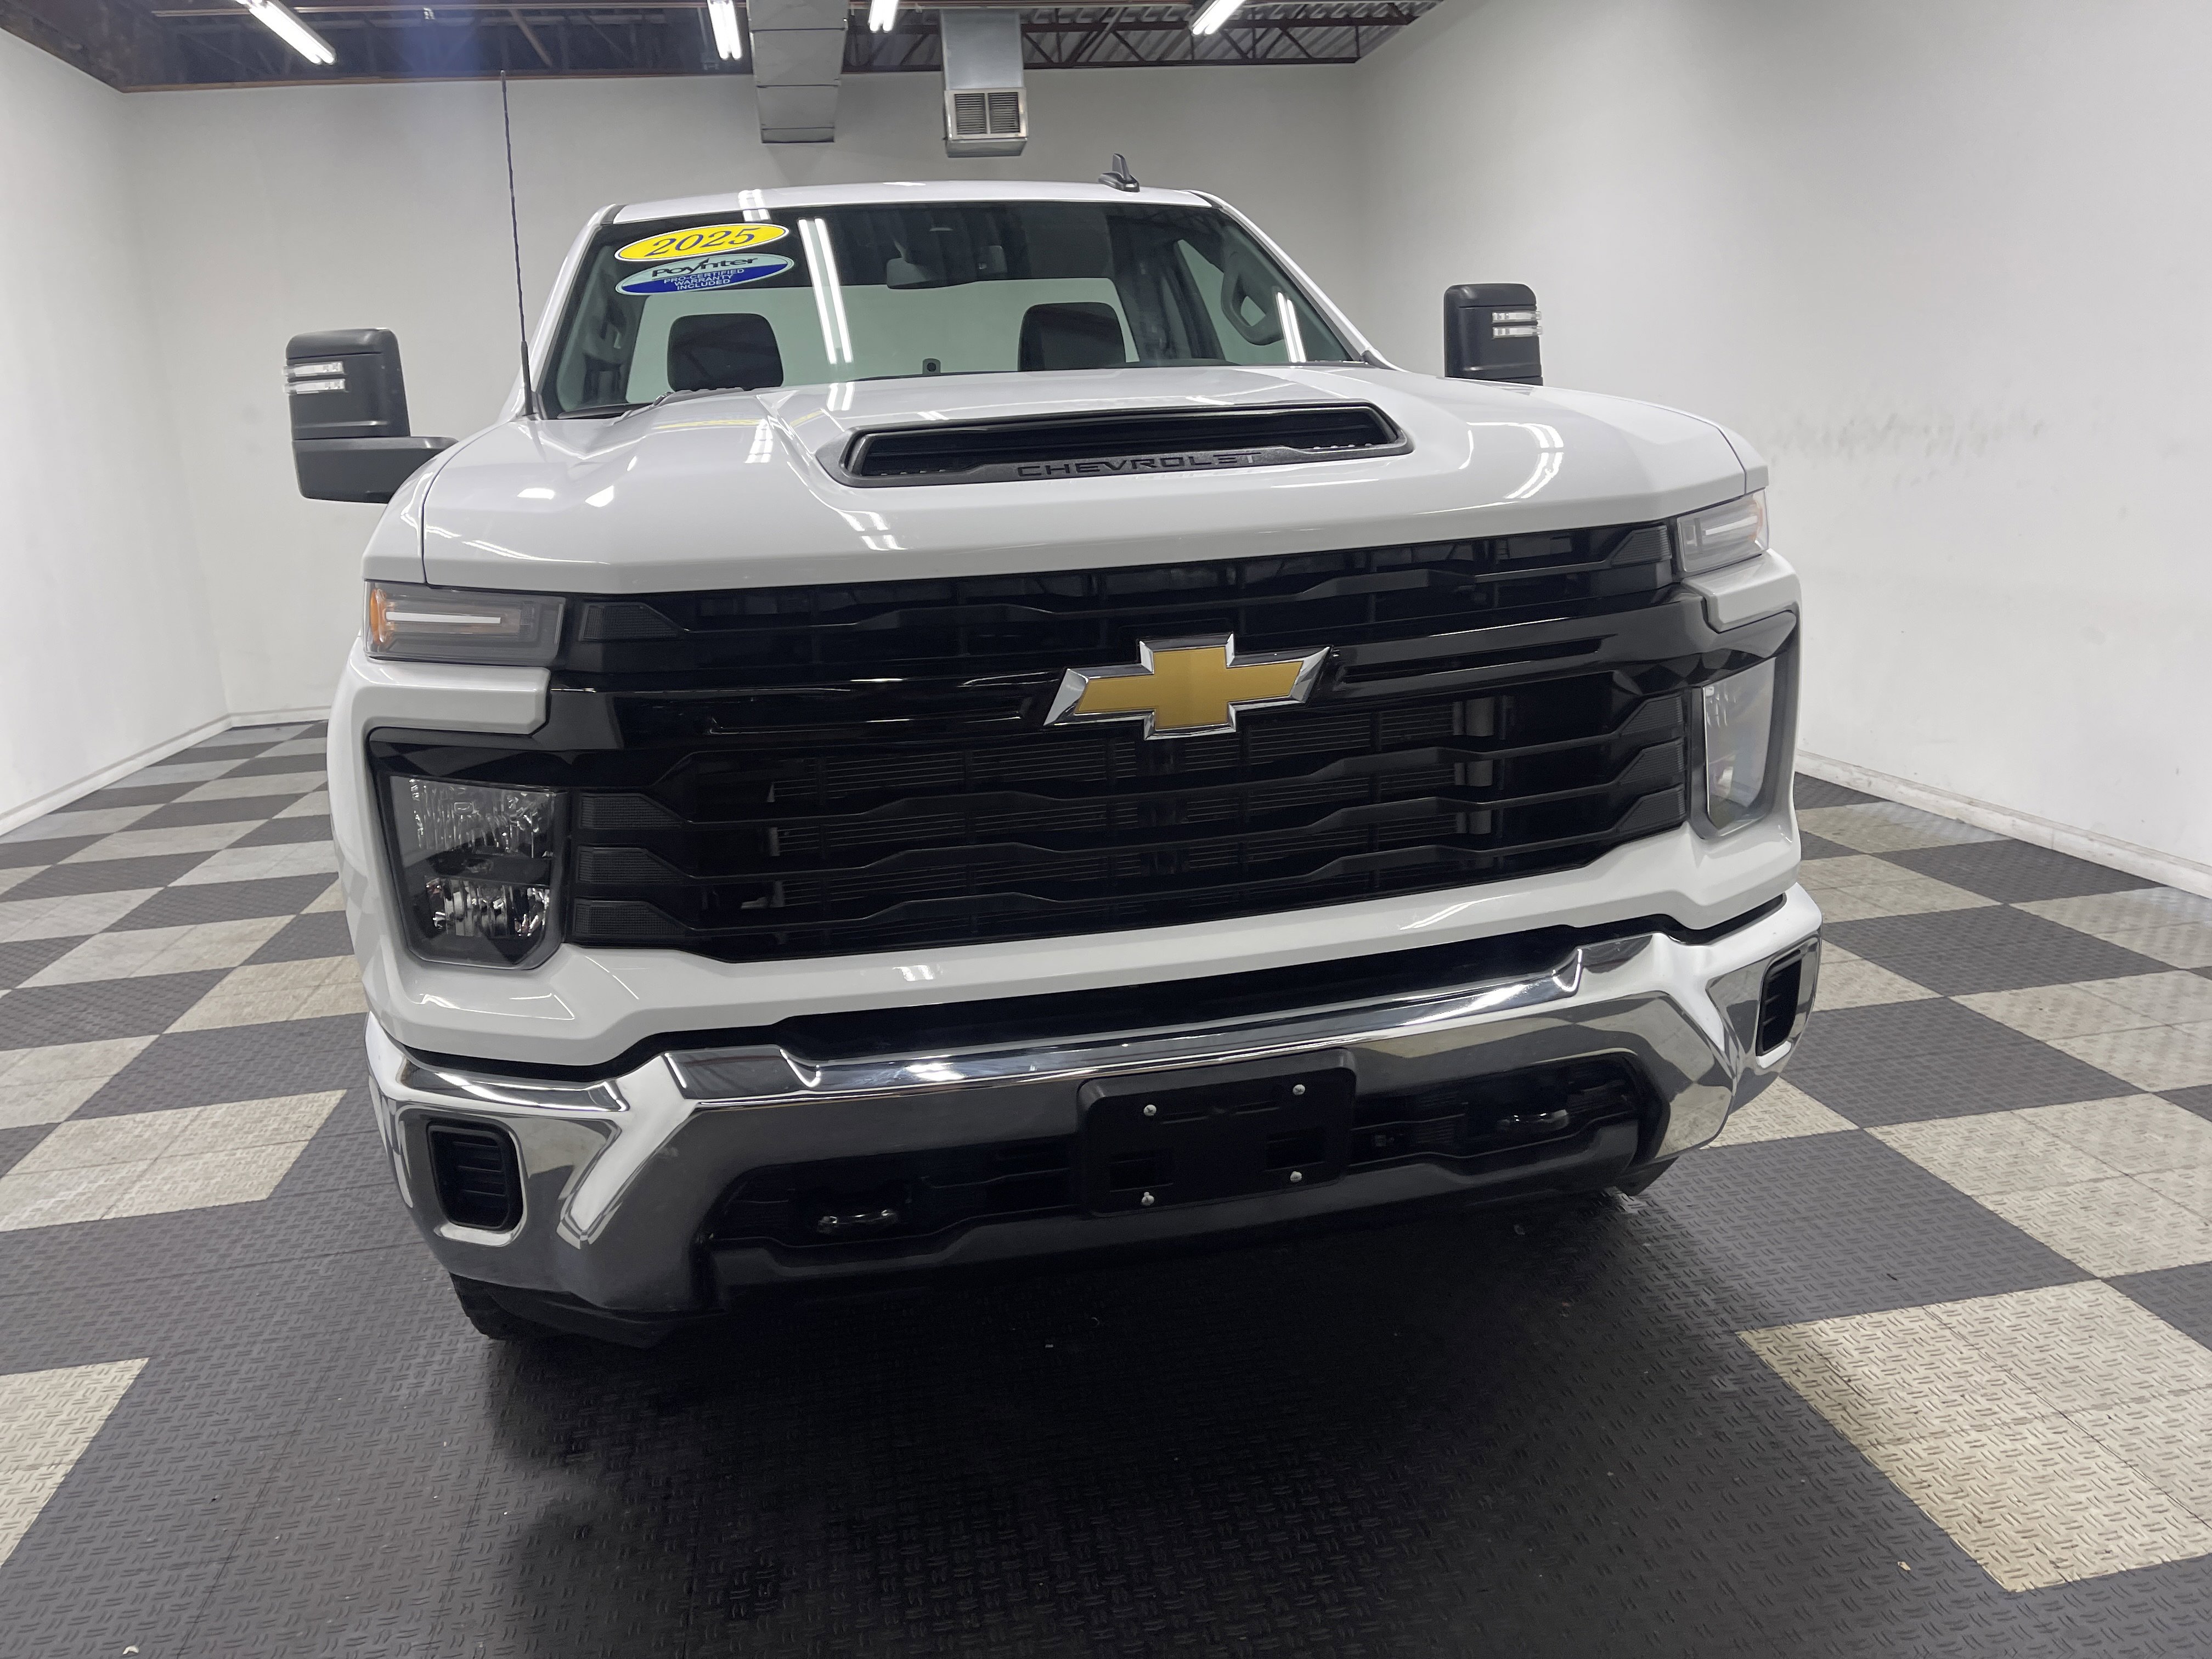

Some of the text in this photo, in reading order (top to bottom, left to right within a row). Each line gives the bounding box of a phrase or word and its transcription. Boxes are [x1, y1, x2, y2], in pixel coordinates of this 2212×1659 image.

[644, 227, 761, 257] 2025
[663, 269, 745, 284] PRO-CERTIFIED
[674, 274, 733, 286] WARRANTY
[677, 279, 730, 290] INCLUDED
[1017, 452, 1262, 477] CHEVROLET
